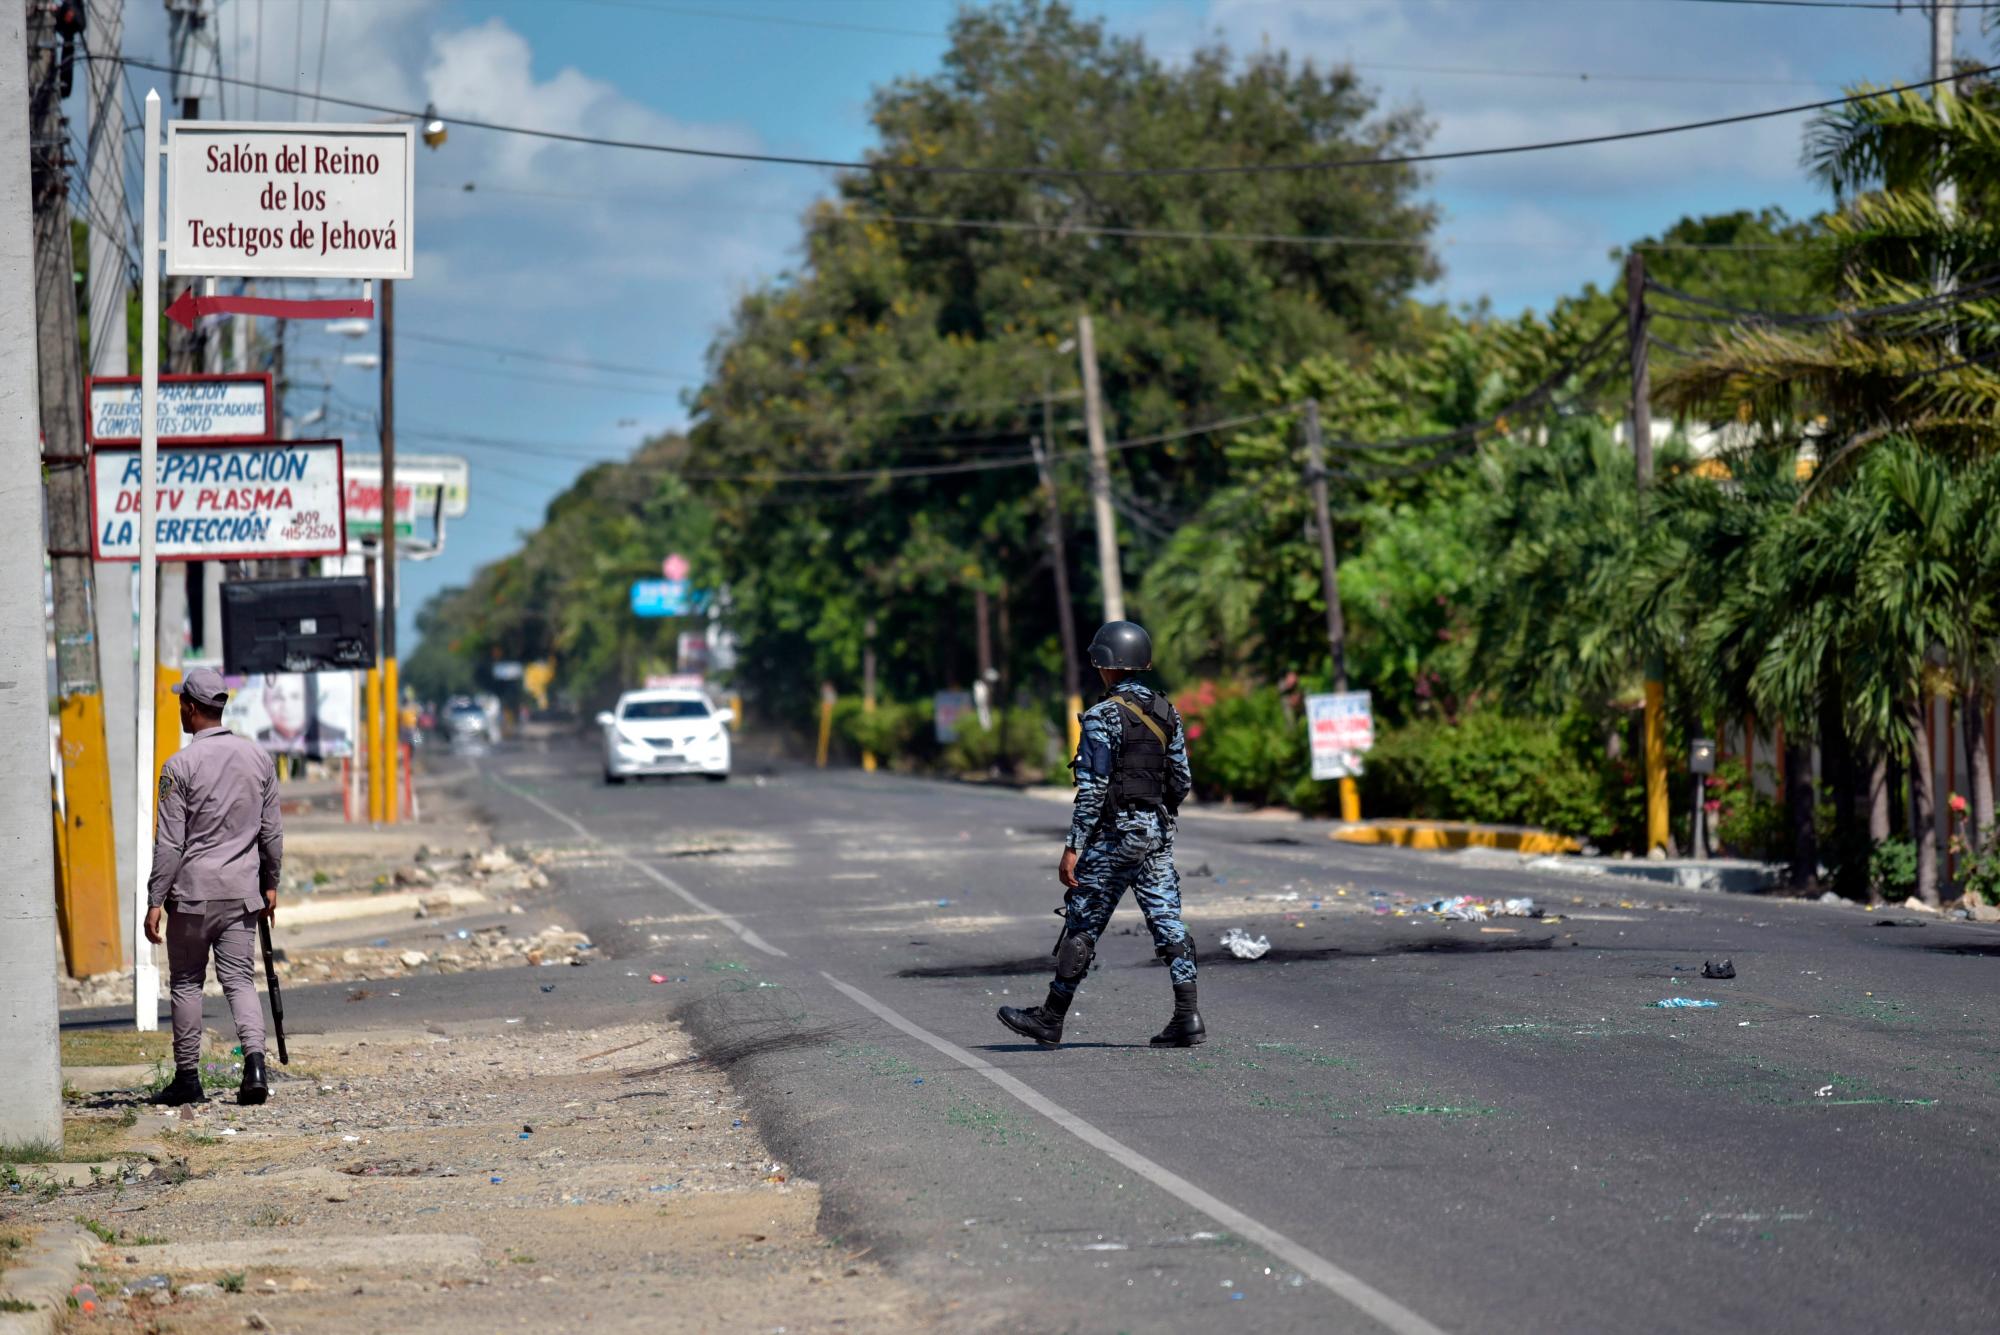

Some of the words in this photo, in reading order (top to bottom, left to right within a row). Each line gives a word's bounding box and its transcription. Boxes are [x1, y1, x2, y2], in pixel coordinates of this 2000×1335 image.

[206, 143, 269, 173] Salón
[275, 144, 307, 173] del
[314, 146, 380, 175] Reino
[260, 181, 287, 211] de
[293, 182, 327, 211] los
[188, 219, 284, 257] Testigos
[290, 220, 314, 249] de
[320, 220, 397, 256] Jehová
[121, 446, 309, 485] RPARACIÓN
[156, 488, 185, 513] TV
[196, 487, 294, 511] PLASMA
[102, 520, 132, 545] LA
[139, 511, 271, 544] ERFECCIÓN
[296, 511, 320, 526] 809
